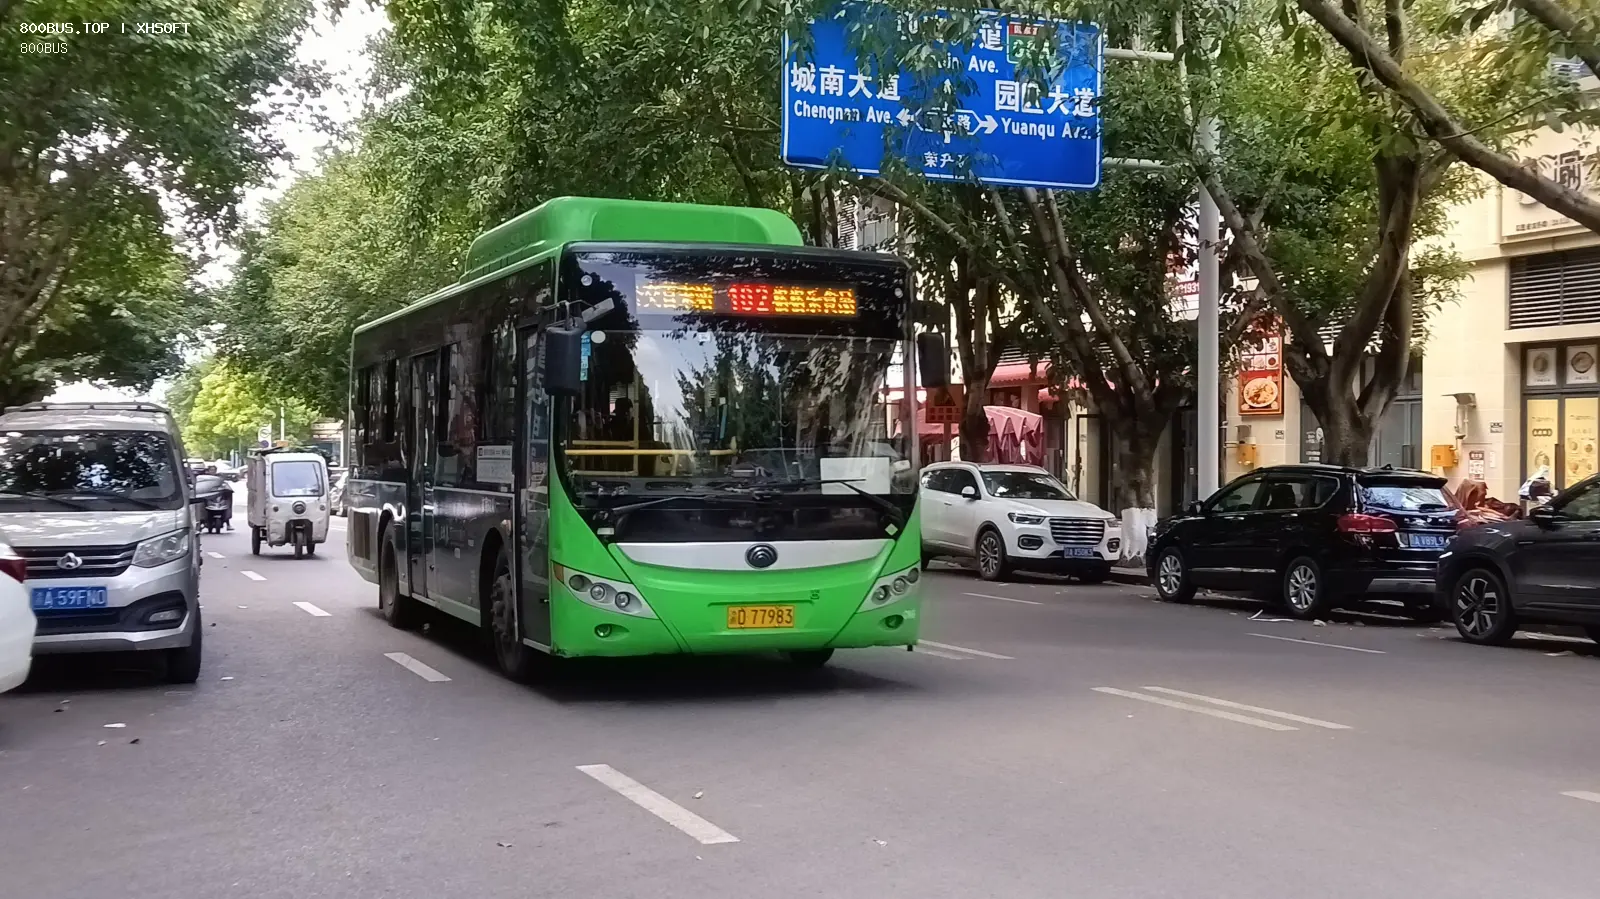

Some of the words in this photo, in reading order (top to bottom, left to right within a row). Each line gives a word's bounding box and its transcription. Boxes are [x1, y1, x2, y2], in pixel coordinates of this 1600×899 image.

[968, 54, 999, 74] Ave.
[790, 61, 901, 101] 城南大道
[995, 79, 1096, 118] 园区大道
[866, 105, 894, 124] Ave.
[1001, 117, 1055, 140] Yuanqu
[728, 284, 769, 311] 102
[751, 608, 793, 625] 77983
